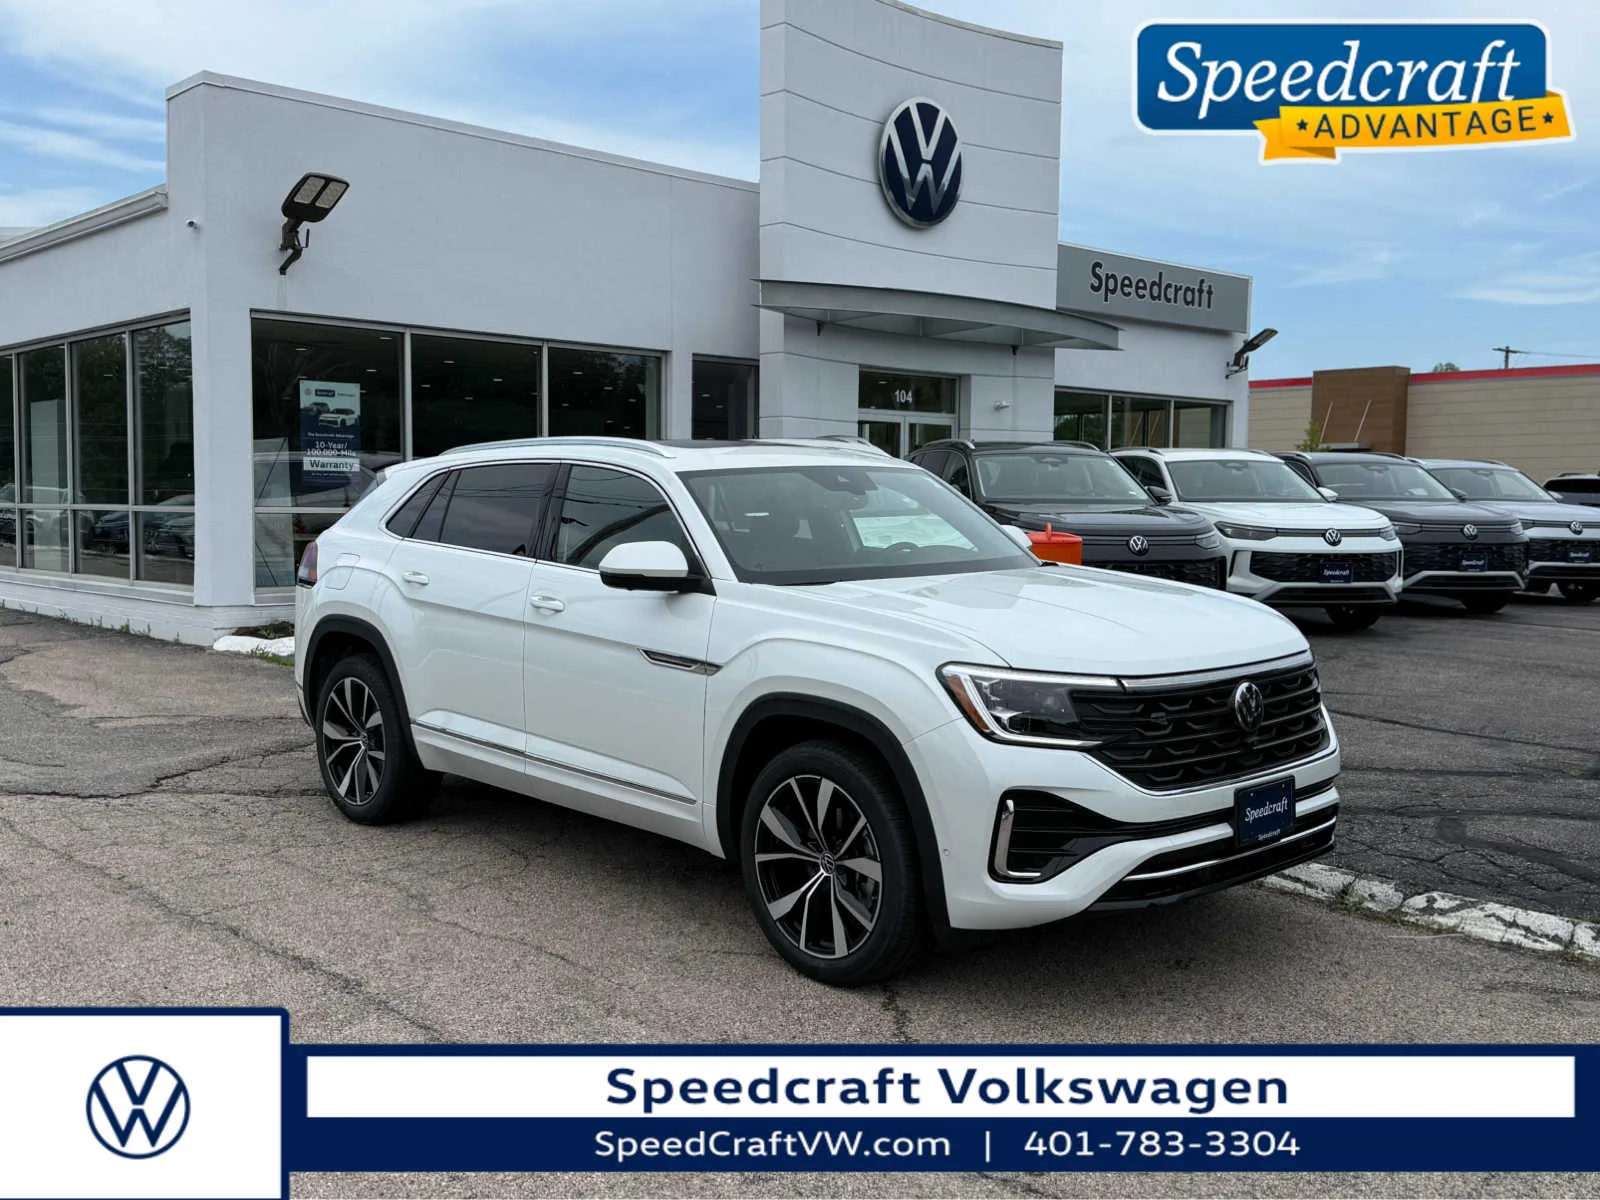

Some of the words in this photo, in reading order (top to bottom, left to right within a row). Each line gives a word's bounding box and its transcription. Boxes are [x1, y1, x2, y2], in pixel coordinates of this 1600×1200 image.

[1090, 260, 1214, 309] Speedcraft
[894, 389, 913, 403] 104
[310, 459, 354, 470] Warranty
[1245, 797, 1288, 823] Speedcraft
